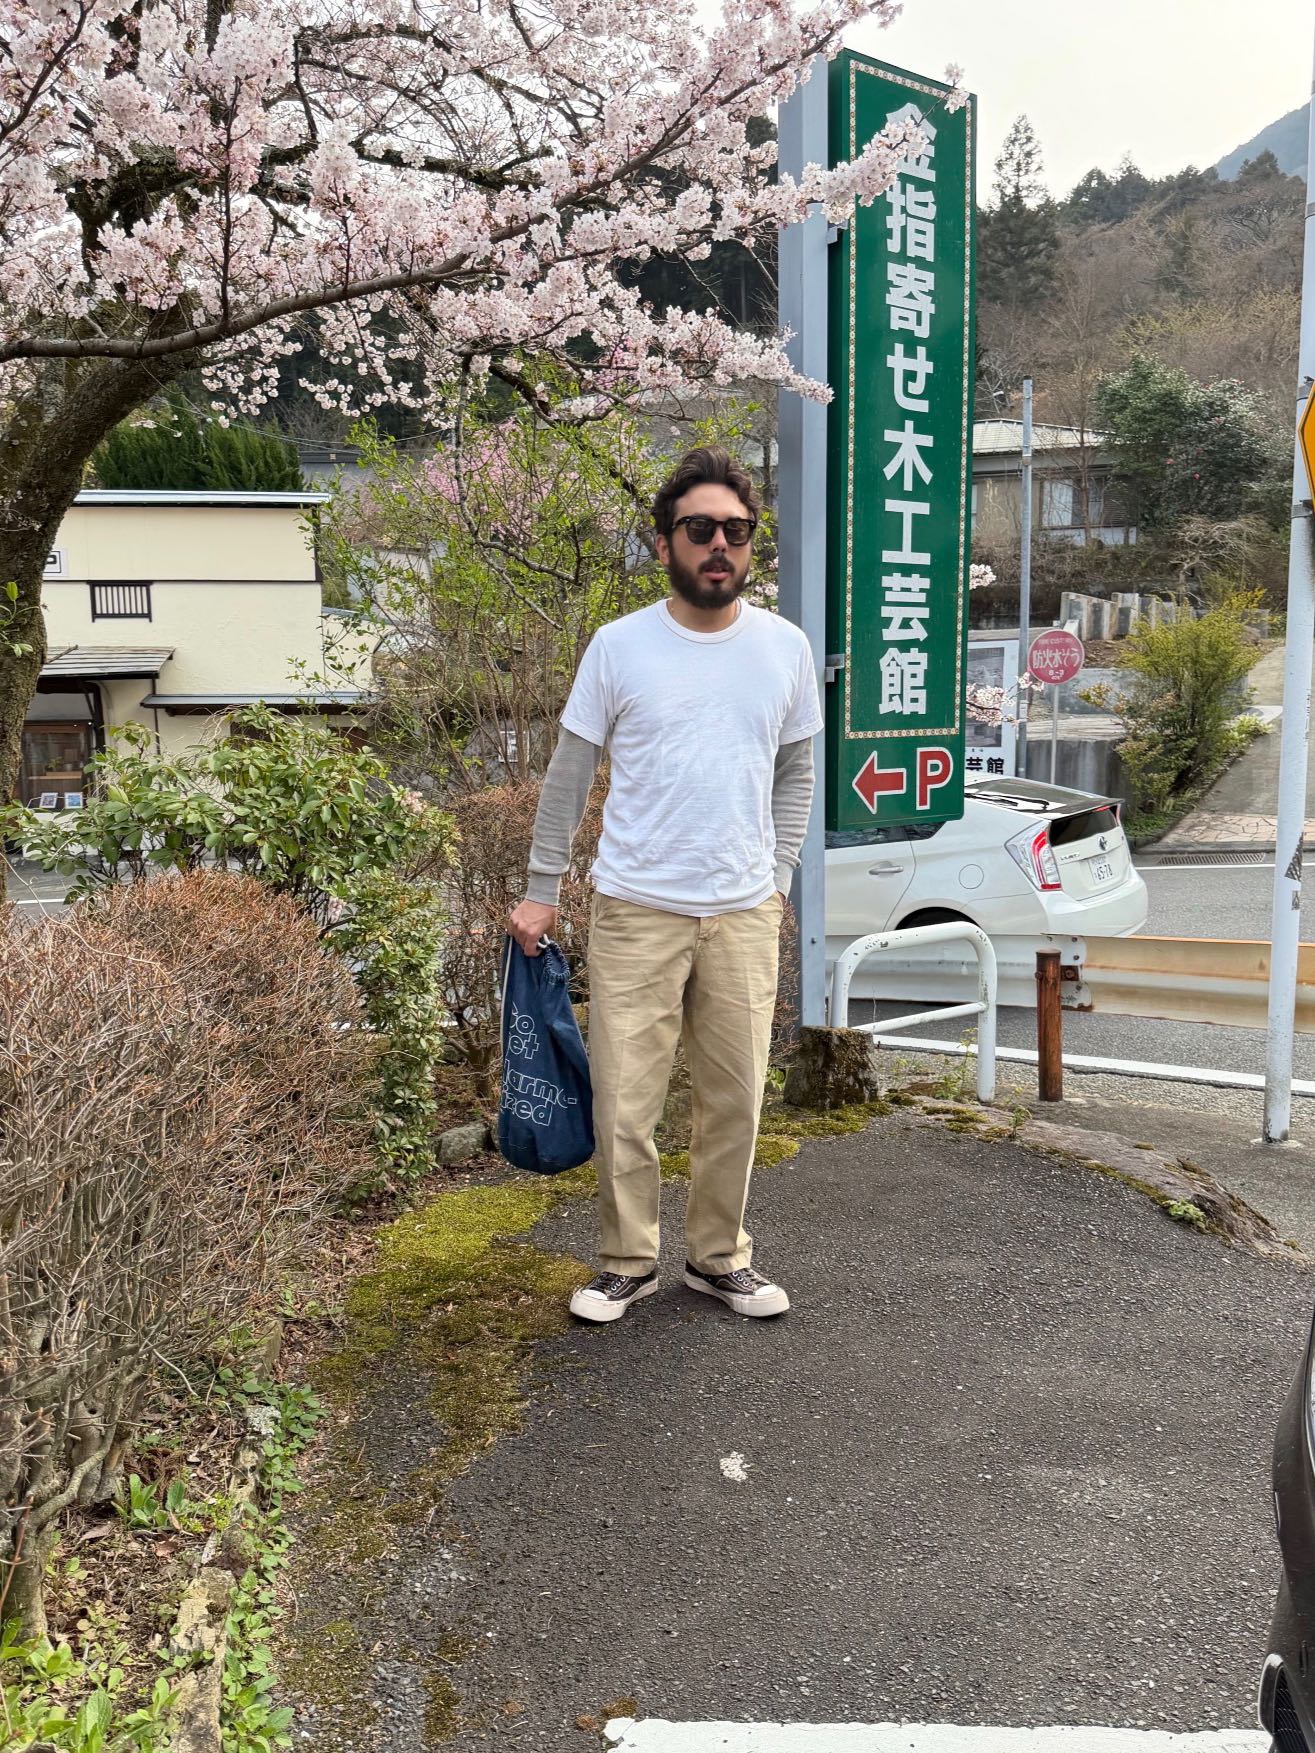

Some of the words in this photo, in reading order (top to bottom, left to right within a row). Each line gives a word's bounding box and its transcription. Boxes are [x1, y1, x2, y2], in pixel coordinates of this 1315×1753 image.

[1032, 648, 1080, 669] 防火水そう
[916, 747, 953, 811] P
